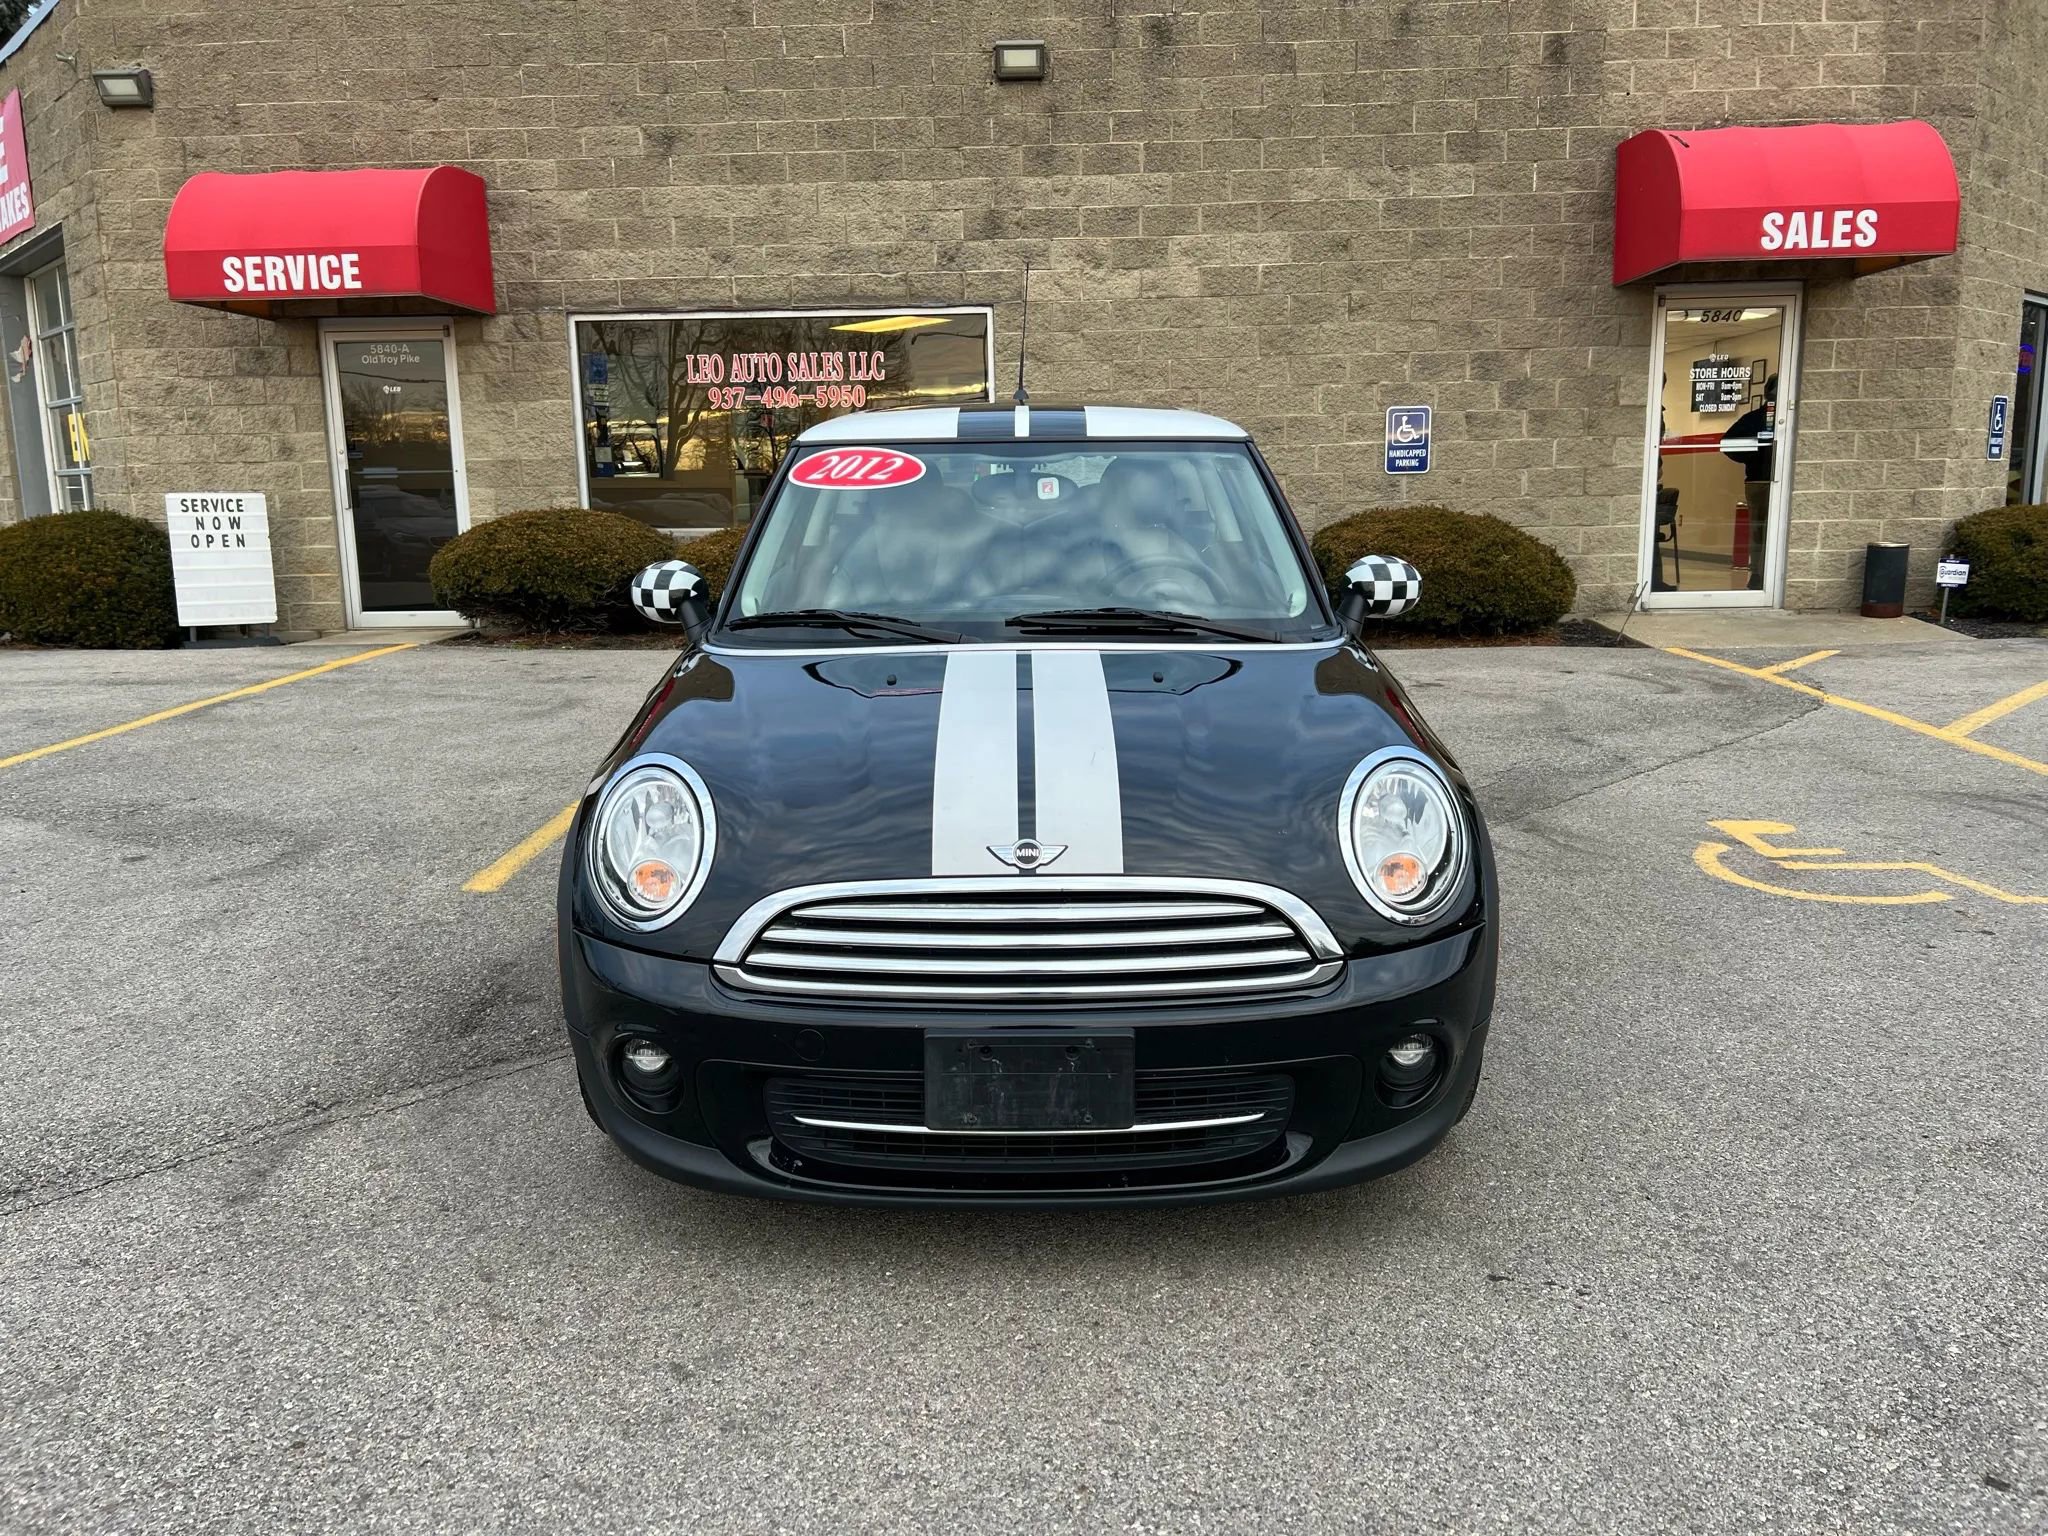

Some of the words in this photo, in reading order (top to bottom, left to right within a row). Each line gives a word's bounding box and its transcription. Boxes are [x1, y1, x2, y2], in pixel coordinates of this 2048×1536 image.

[0, 181, 29, 233] AKES
[1760, 209, 1878, 251] SALES
[222, 253, 362, 293] SERVICE
[1700, 309, 1743, 322] 5840
[370, 344, 410, 354] 5840-A
[361, 354, 378, 364] Old
[379, 354, 398, 366] Troy
[400, 354, 420, 363] Pike
[685, 353, 725, 384] LEO
[730, 352, 783, 383] AUTO
[787, 351, 844, 382] SALES
[848, 350, 886, 381] LLC
[1689, 367, 1718, 379] STORE
[1720, 366, 1751, 378] HOURS
[707, 384, 867, 410] 937-496-5950
[1695, 393, 1704, 402] SAT
[1699, 403, 1717, 412] CLOSED
[1718, 403, 1736, 412] SUNDAY
[1388, 449, 1427, 458] HANDICAPPED
[805, 453, 905, 481] 2012
[1395, 459, 1419, 467] PARKING
[180, 498, 245, 513] SERVICE
[195, 516, 241, 530] NOW
[190, 533, 246, 549] OPEN
[1016, 848, 1040, 857] MINI
